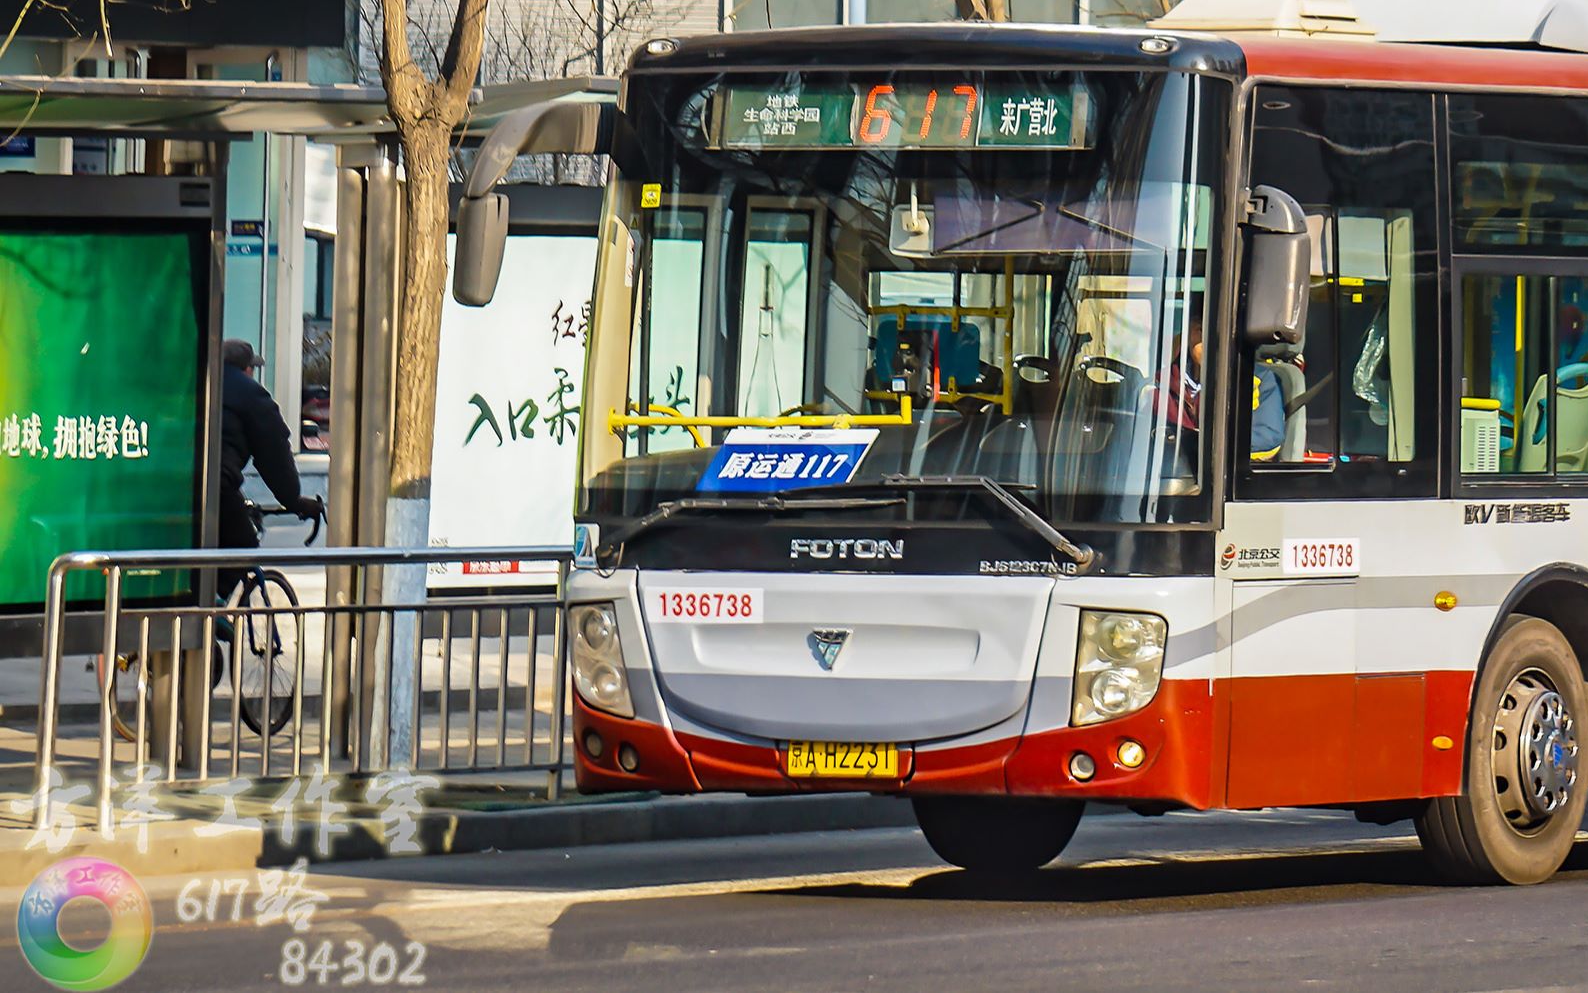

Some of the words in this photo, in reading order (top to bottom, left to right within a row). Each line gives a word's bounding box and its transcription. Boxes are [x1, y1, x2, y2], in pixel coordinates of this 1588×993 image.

[742, 107, 820, 123] 生命科学园
[859, 84, 979, 143] 617
[1000, 97, 1057, 137] 来广营北
[763, 122, 797, 136] 站西
[718, 452, 849, 480] 原运通117
[789, 538, 905, 559] FOTON
[1238, 548, 1280, 561] 北京公交
[1292, 543, 1353, 568] 1336738
[659, 593, 753, 618] 1336738
